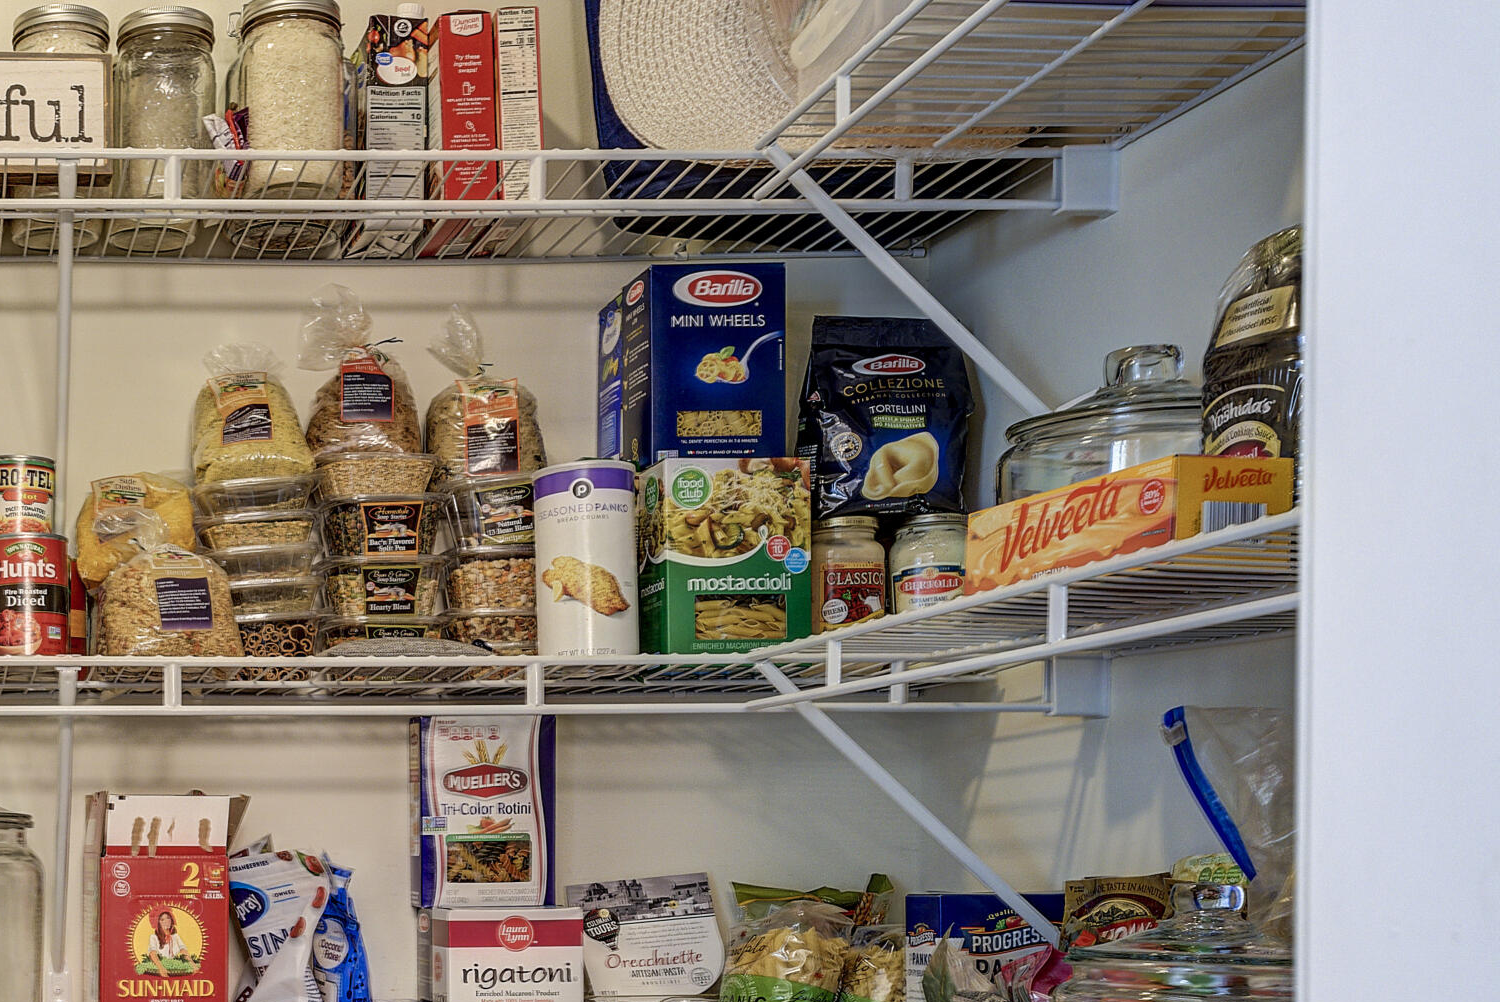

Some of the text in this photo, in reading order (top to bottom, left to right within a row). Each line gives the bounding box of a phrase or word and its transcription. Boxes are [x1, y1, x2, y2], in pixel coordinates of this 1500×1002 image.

[452, 17, 480, 27] Duncan
[411, 112, 422, 120] 10
[694, 278, 756, 296] Barilla
[671, 314, 766, 328] MINI WHEELS
[871, 358, 919, 370] Barilla
[843, 378, 946, 398] COLLEZIONE
[869, 404, 927, 414] TORTELLINI
[1209, 399, 1274, 432] Yoshida's
[1254, 426, 1275, 441] Sauce
[678, 477, 704, 489] food
[1203, 467, 1274, 494] Velveeta
[678, 487, 704, 500] club
[498, 518, 523, 528] Natural
[579, 513, 610, 521] CRUMBS
[514, 523, 534, 532] Blend
[1001, 477, 1123, 573] Velveeta
[389, 537, 415, 545] Flavored
[19, 542, 45, 555] NATURAL
[378, 544, 393, 552] Split
[772, 544, 784, 554] 10
[688, 573, 792, 592] mostaccioli
[827, 571, 885, 586] CLASSICO
[19, 588, 48, 596] Roasted
[903, 579, 960, 593] BERTOLLI
[6, 594, 46, 607] Diced
[370, 602, 411, 612] Hearty Blend
[823, 606, 847, 618] FRESH
[692, 640, 761, 650] ENRICHED MACARONI
[450, 770, 522, 792] MUELLER'S
[440, 801, 532, 816] Tri-Color Rotini
[232, 860, 270, 872] CRANBERRIES
[182, 861, 200, 888] 2
[274, 889, 296, 897] OWNED
[1105, 882, 1166, 901] TASTE MINUTES
[586, 916, 613, 928] CULINARY
[501, 924, 528, 936] Laura
[588, 922, 619, 937] TOURS
[507, 932, 530, 944] Lynn
[910, 931, 935, 945] PROGRESSO
[604, 949, 704, 969] Orecchiette
[462, 963, 572, 990] rigatoni
[631, 966, 687, 978] ARTISAN PASTA
[535, 990, 560, 998] Product
